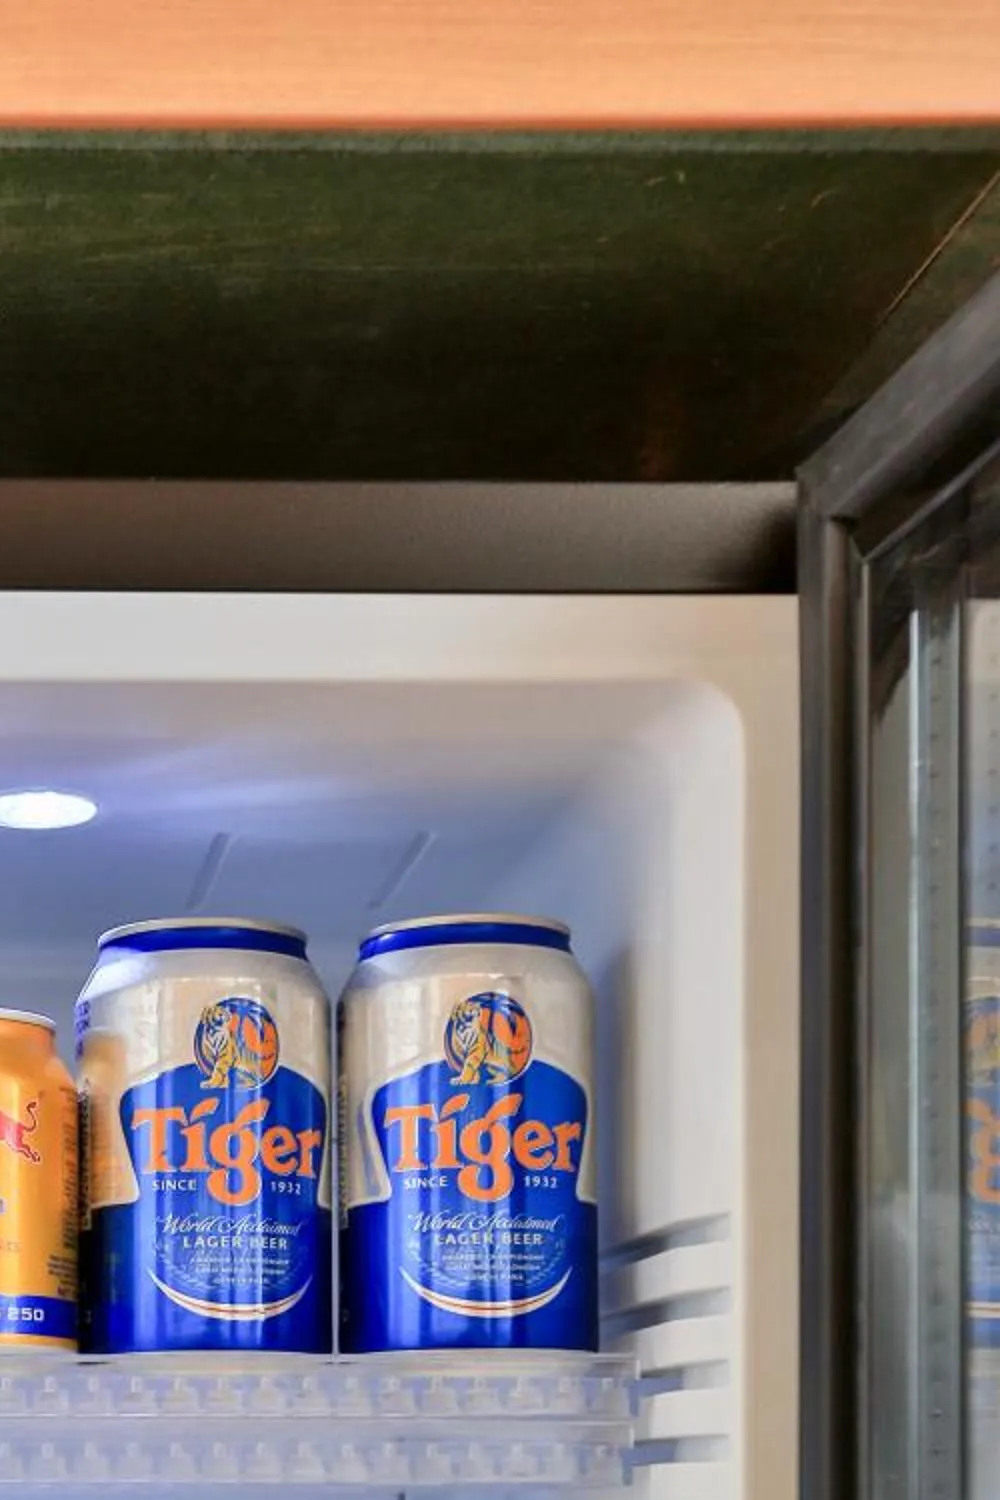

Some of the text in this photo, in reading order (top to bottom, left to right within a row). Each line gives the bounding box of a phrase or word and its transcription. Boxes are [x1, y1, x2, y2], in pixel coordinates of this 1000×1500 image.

[131, 1098, 320, 1206] Tiger
[384, 1094, 582, 1202] Tiger
[151, 1179, 198, 1191] SINCE
[270, 1181, 301, 1195] 1932
[404, 1176, 449, 1189] SINCE
[523, 1176, 558, 1188] 1932
[183, 1235, 288, 1249] LAGER BEER
[435, 1232, 544, 1246] LAGER BEER
[7, 1307, 45, 1322] 250
